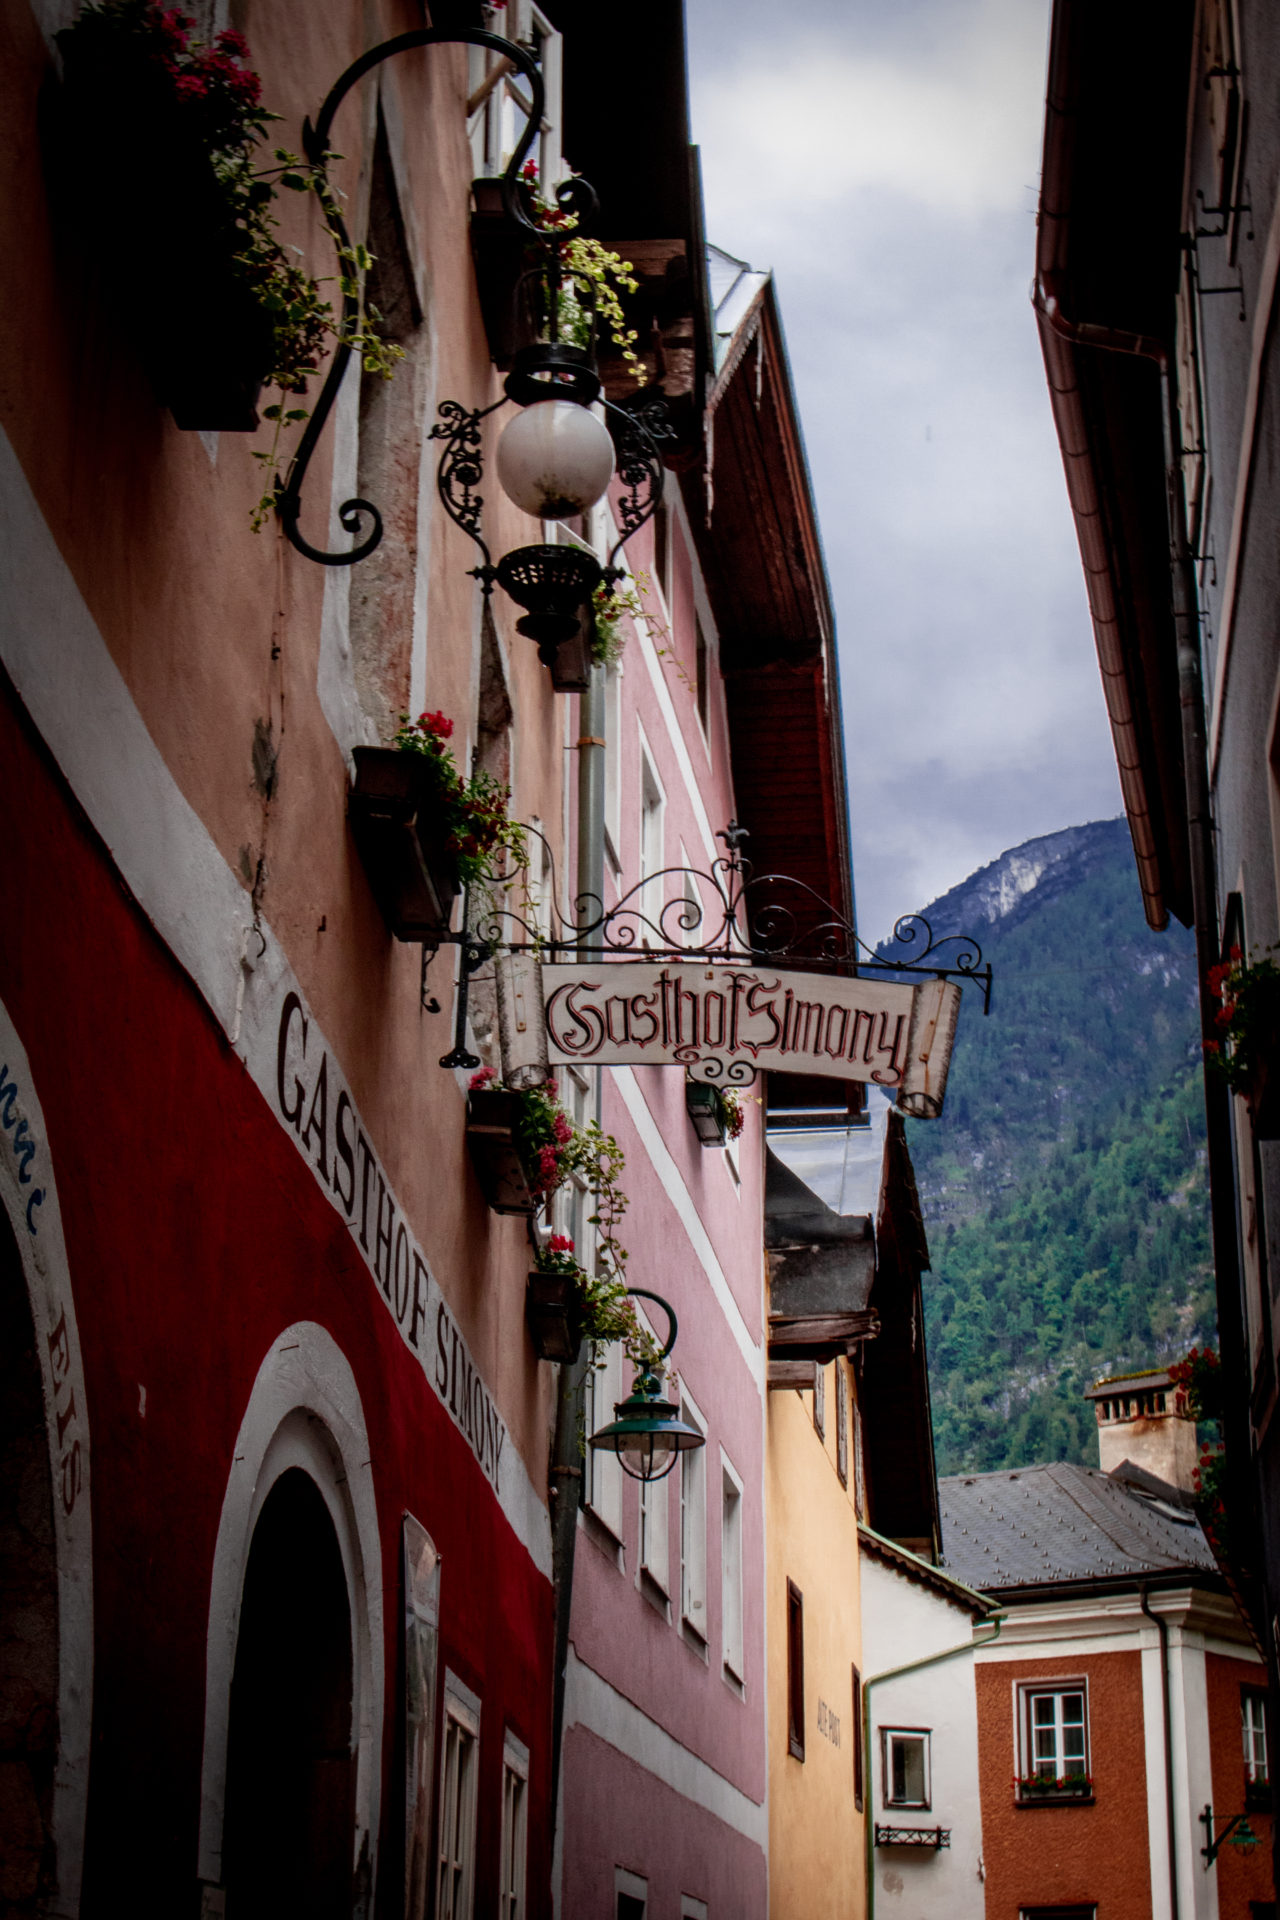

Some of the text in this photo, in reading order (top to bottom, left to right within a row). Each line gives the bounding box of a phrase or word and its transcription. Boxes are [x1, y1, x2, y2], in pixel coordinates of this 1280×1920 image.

[546, 969, 907, 1085] Gasthof Simony
[278, 991, 505, 1495] GASTHOF SIMONY
[47, 1301, 82, 1516] EIS
